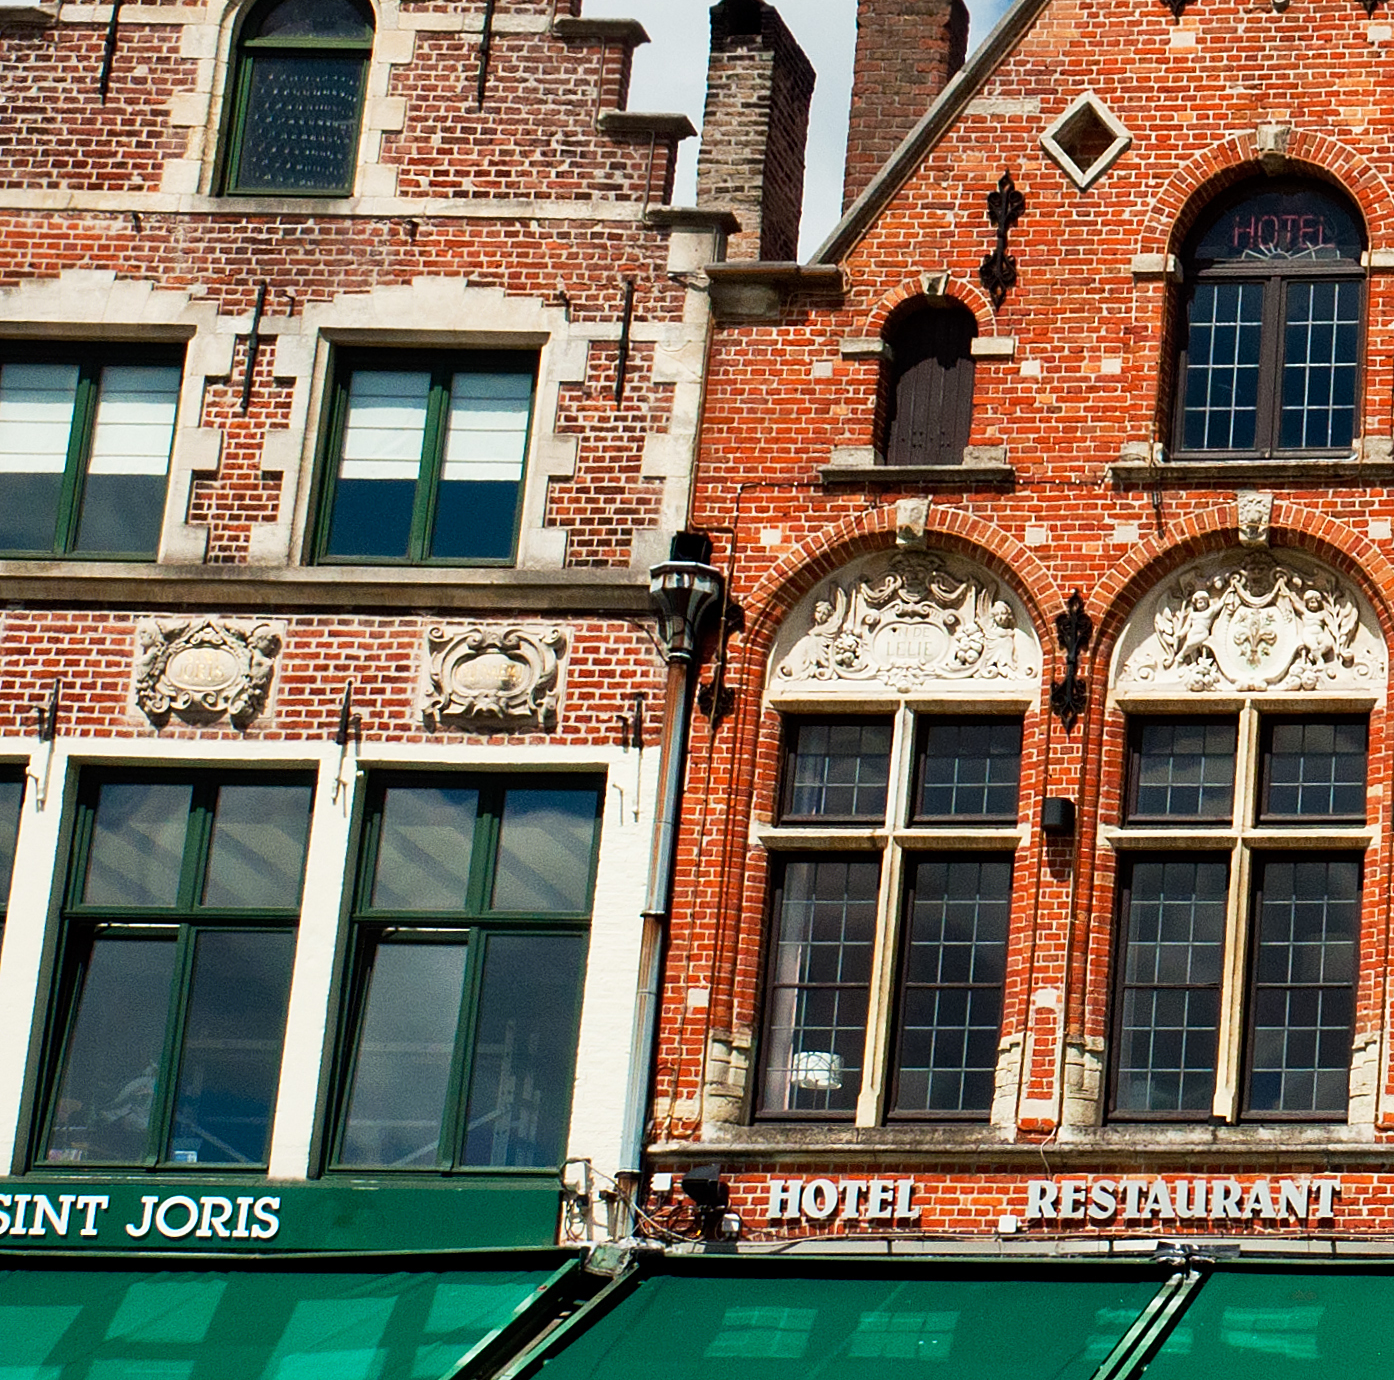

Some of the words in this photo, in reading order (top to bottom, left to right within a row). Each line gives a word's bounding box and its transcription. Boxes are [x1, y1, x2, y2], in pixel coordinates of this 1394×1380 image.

[1232, 215, 1336, 248] HOTEL
[886, 642, 932, 656] LELIE
[126, 1195, 281, 1239] JORIS
[765, 1179, 920, 1219] HOTEL
[1026, 1179, 1341, 1220] RESTAURANT
